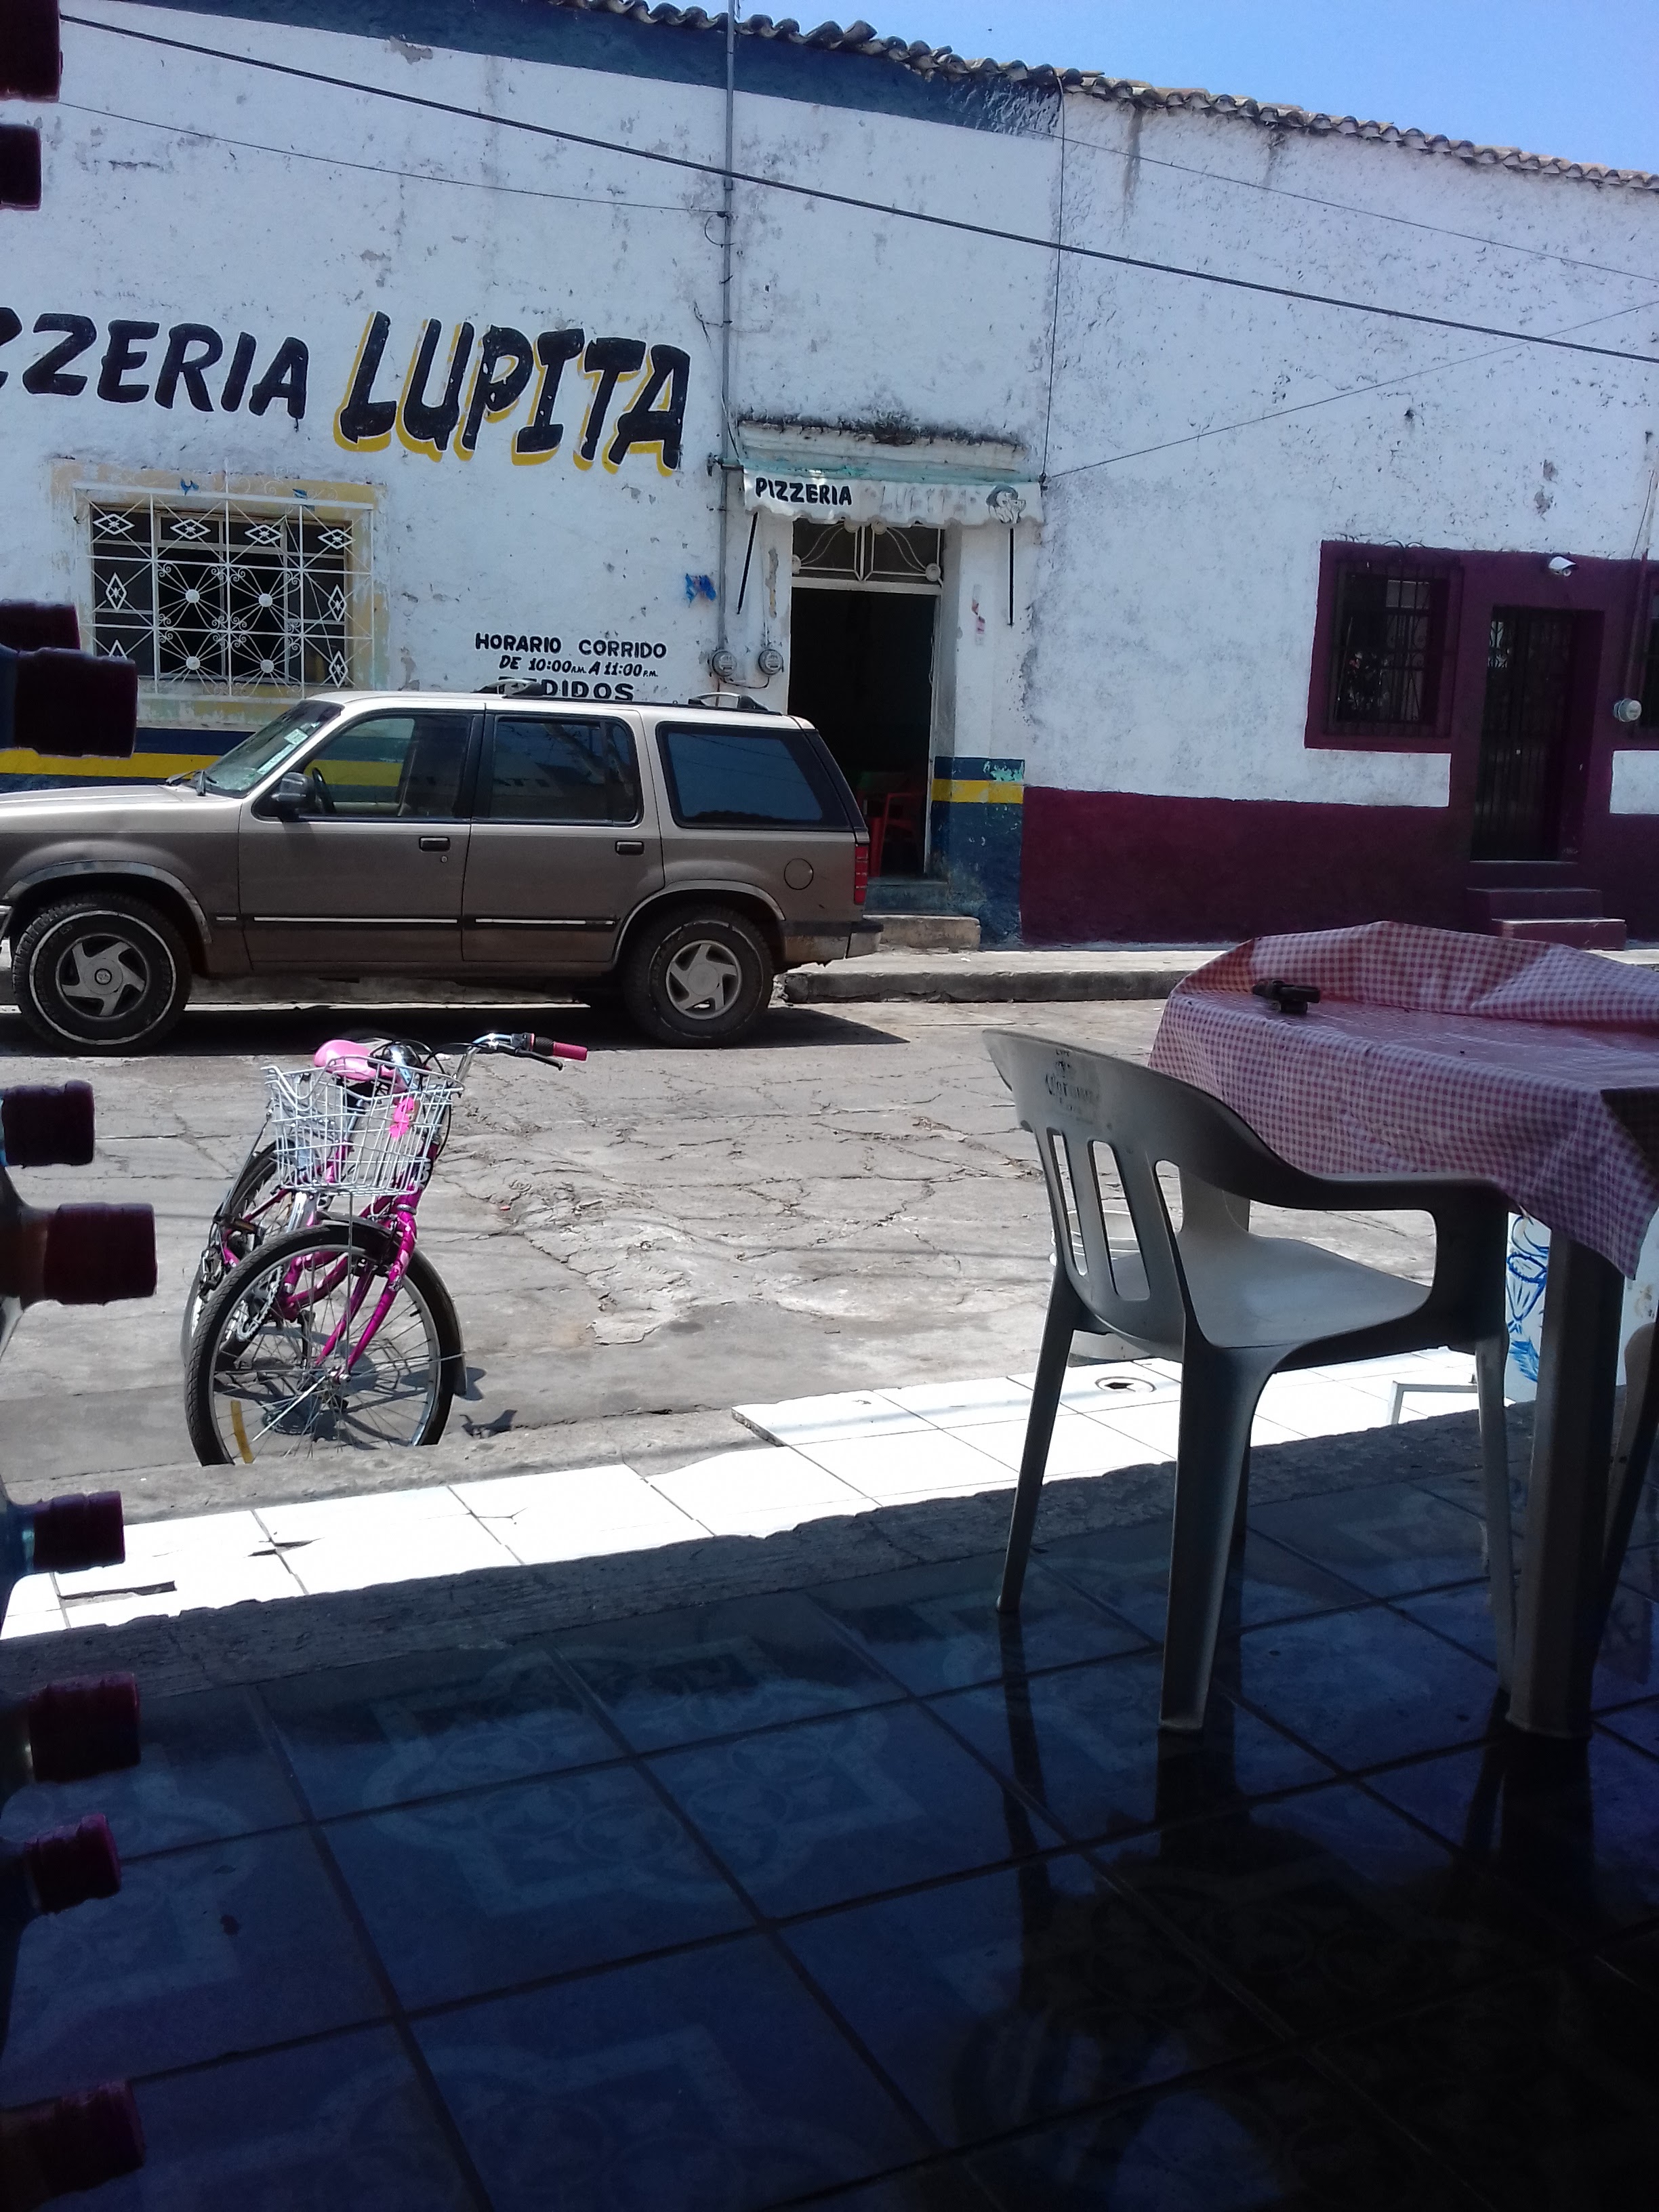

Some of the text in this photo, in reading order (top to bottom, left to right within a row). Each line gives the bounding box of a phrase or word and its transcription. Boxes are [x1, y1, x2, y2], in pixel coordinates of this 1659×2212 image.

[334, 310, 692, 475] LUPITA
[756, 477, 852, 506] PIZZERIA
[475, 632, 667, 659] HORARIO CORRIDO
[499, 655, 522, 670] DE
[588, 660, 601, 676] A
[498, 676, 634, 701] DIDOS
